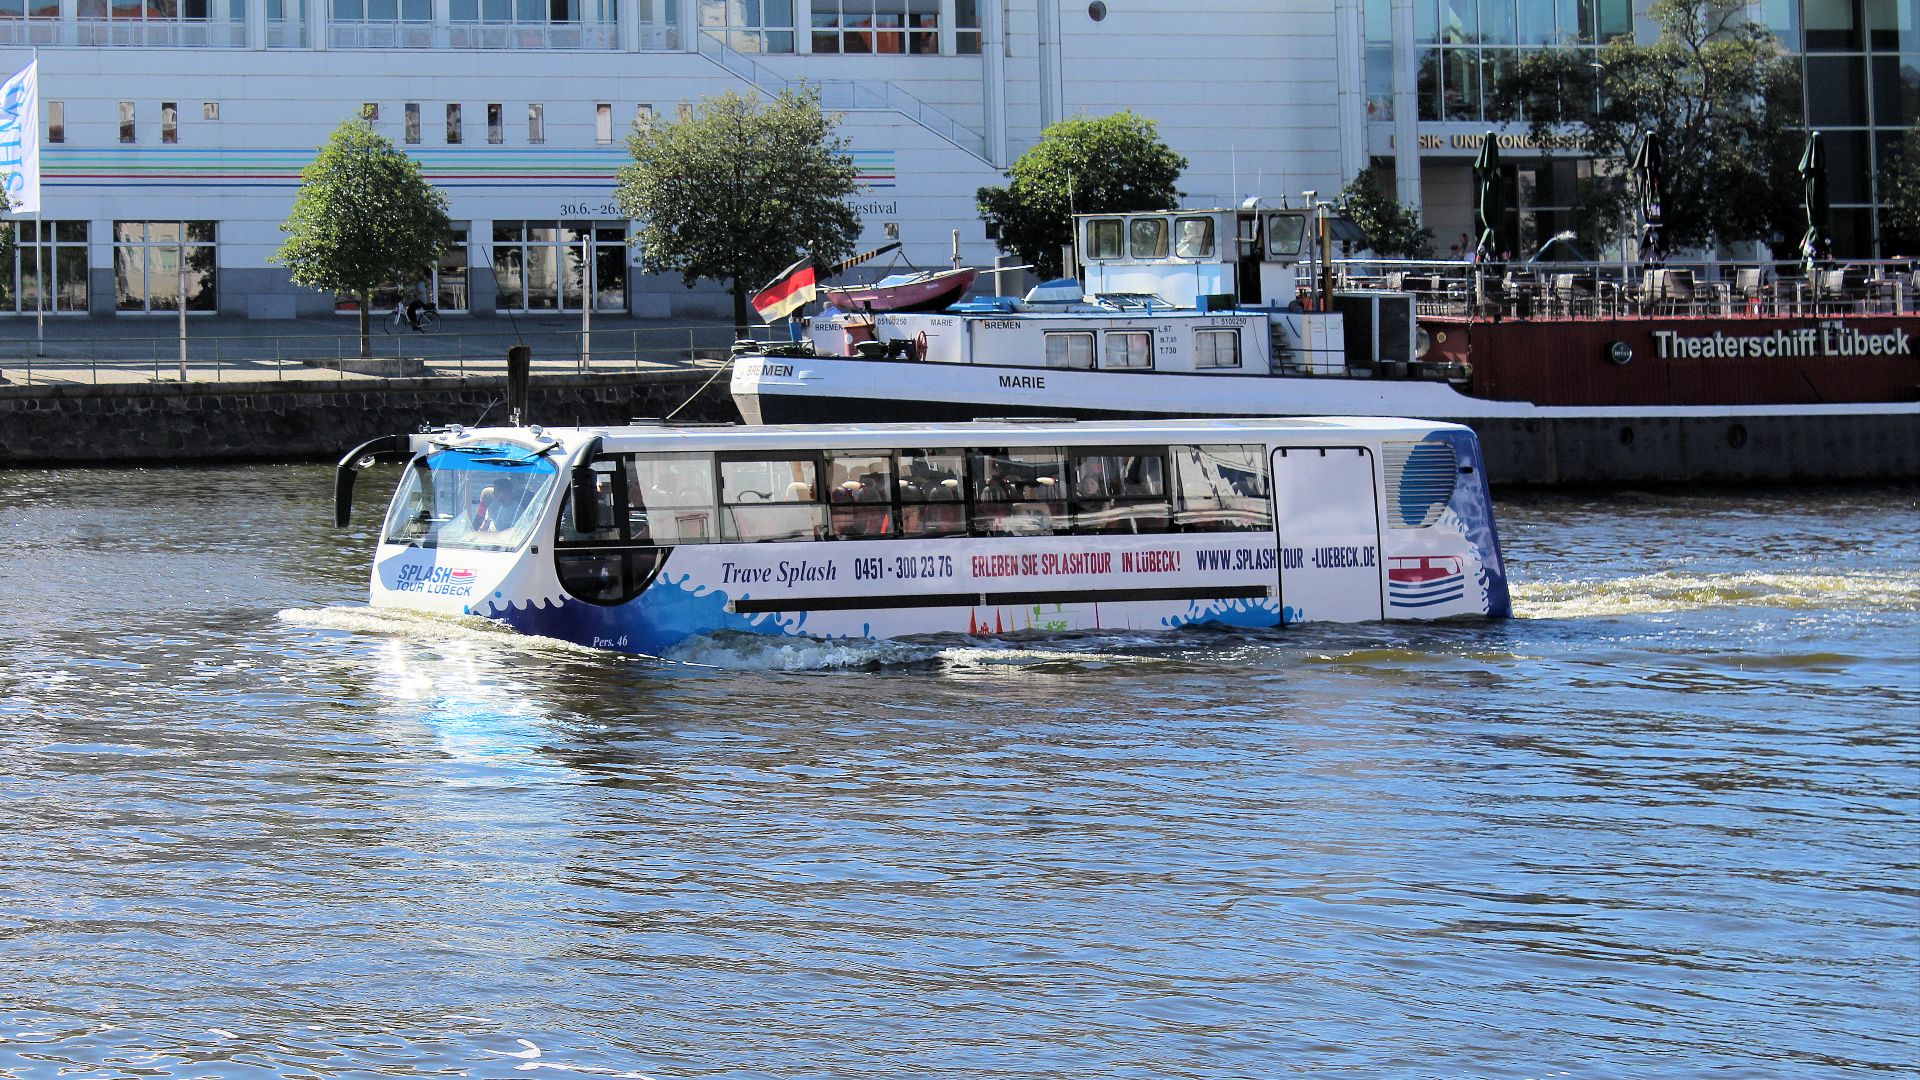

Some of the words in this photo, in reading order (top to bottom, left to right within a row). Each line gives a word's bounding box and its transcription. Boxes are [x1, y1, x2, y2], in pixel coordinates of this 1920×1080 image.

[1390, 134, 1444, 149] SIK-
[1451, 134, 1486, 149] UND
[847, 201, 897, 215] Festival
[814, 323, 843, 332] BREMEN
[930, 318, 953, 327] MARIE
[984, 321, 1021, 330] BREMEN
[1654, 329, 1816, 359] Theaterschiff
[1822, 327, 1911, 357] Lübeck
[746, 364, 794, 377] BREMEN
[998, 374, 1046, 389] MARIE
[1311, 545, 1376, 569] -LUEBECK.DE
[721, 561, 772, 584] Trave
[776, 559, 837, 588] Splash
[854, 557, 884, 580] 0451
[896, 556, 917, 579] 300
[920, 555, 936, 578] 23
[938, 555, 953, 578] 76
[971, 554, 1019, 578] ERLEBEN
[1021, 553, 1039, 576] SIE
[1041, 551, 1112, 575] SPLASHTOUR
[1121, 551, 1134, 573] IN
[398, 563, 453, 584] SPLASH
[395, 580, 425, 593] TOUR
[592, 636, 615, 648] Pers.
[616, 634, 628, 647] 46
